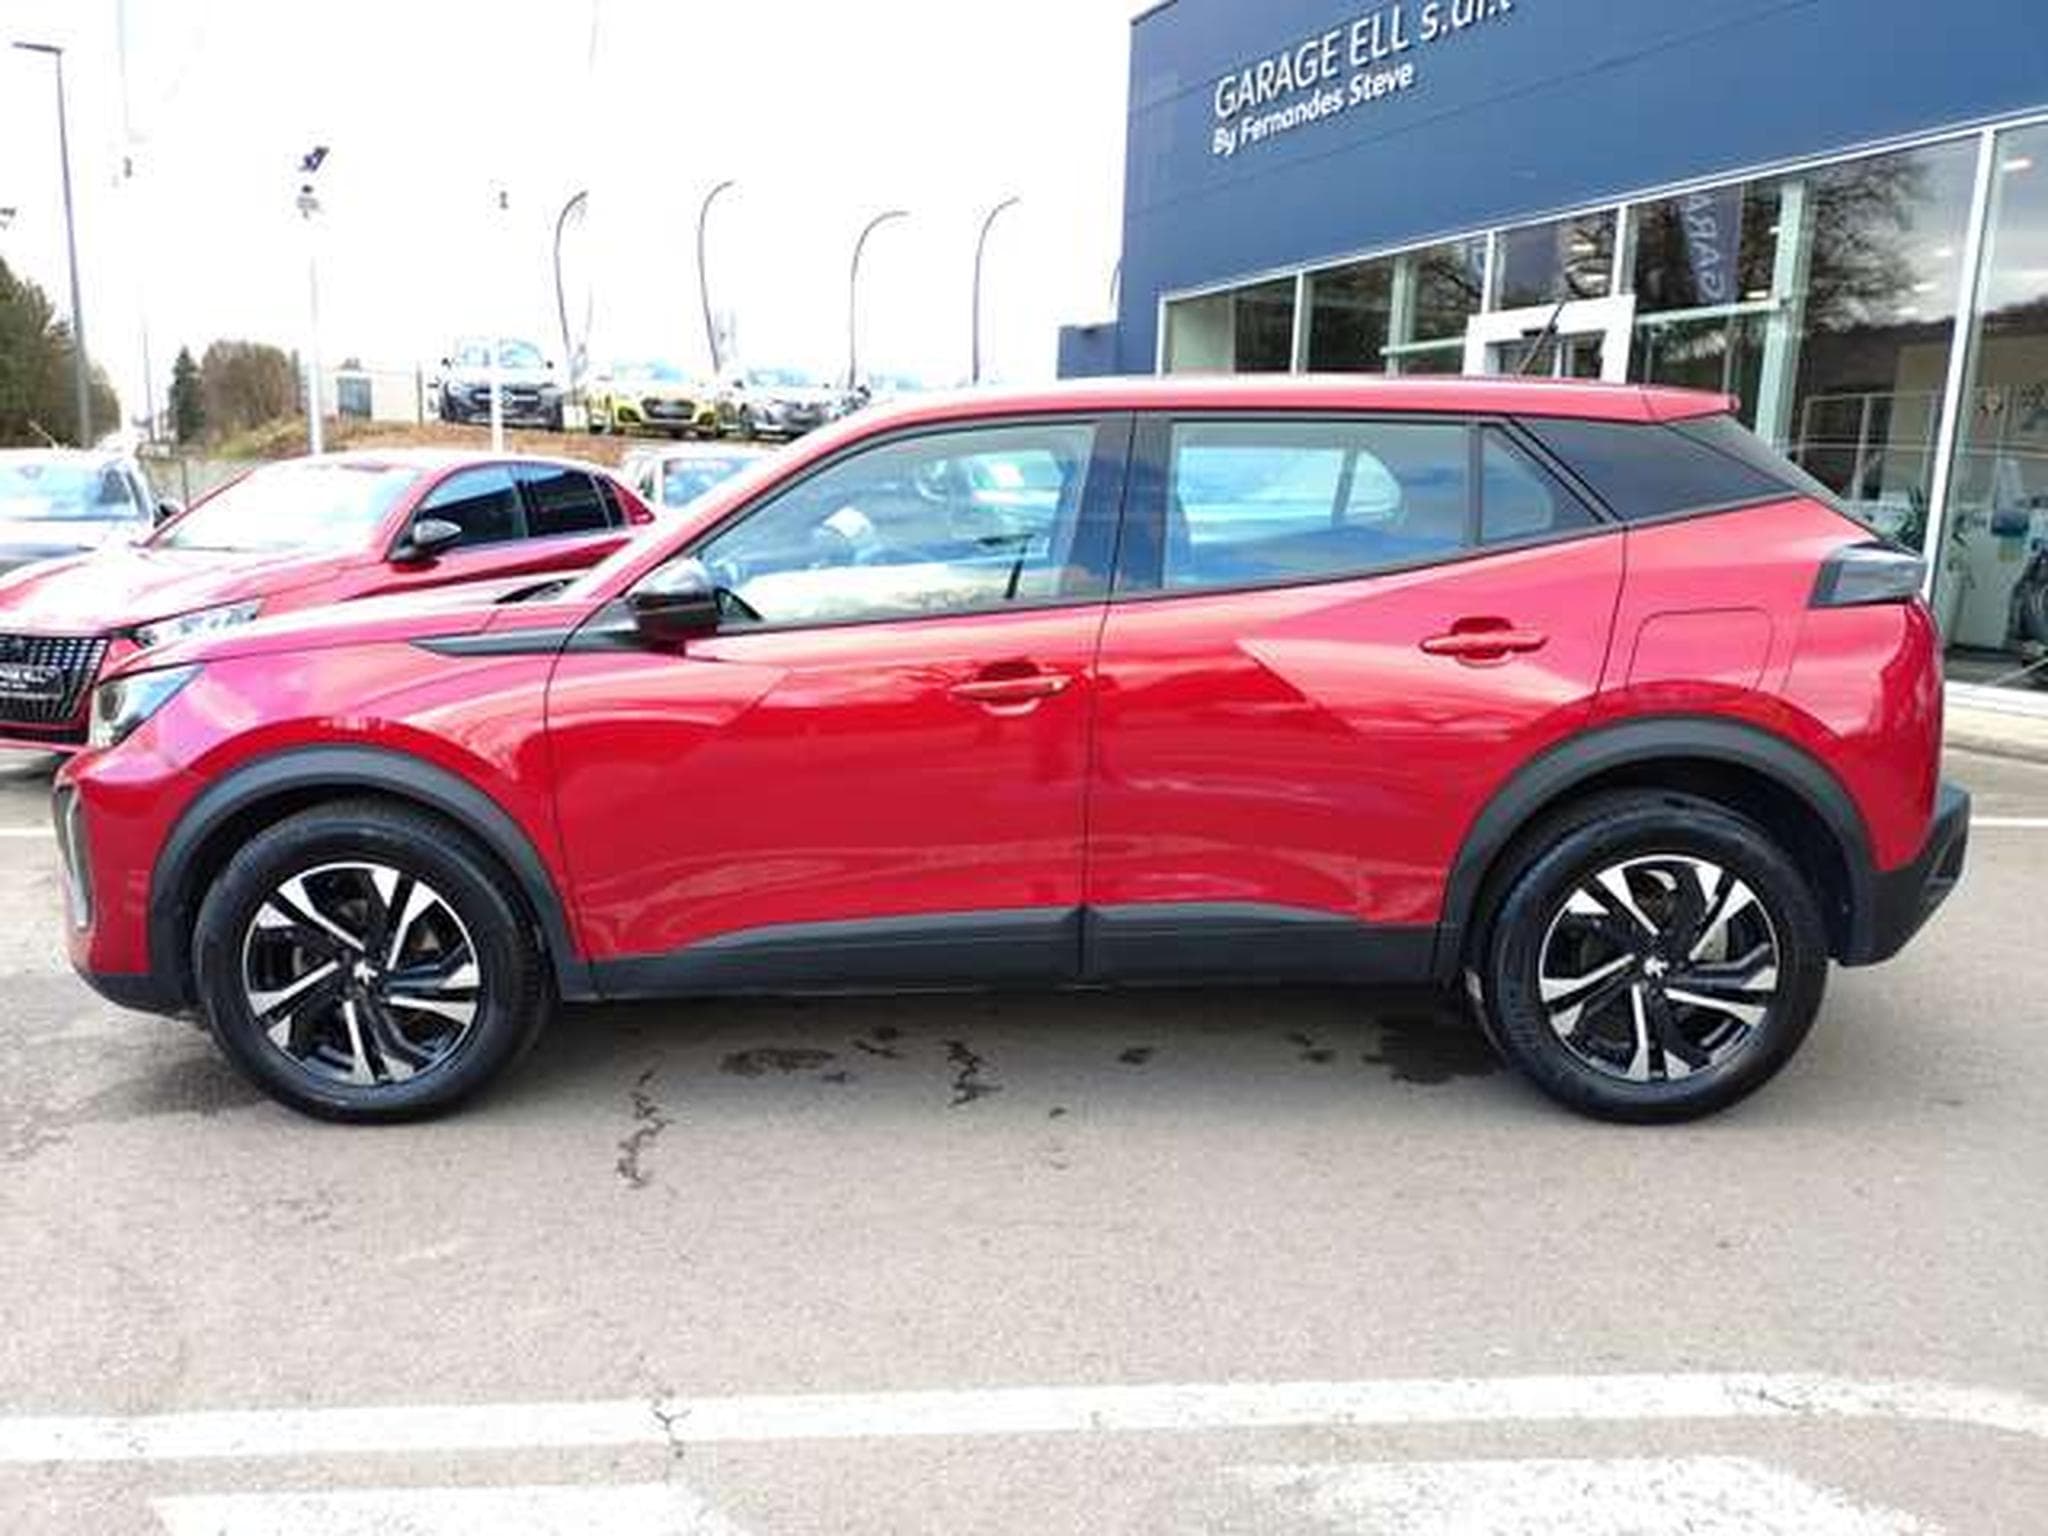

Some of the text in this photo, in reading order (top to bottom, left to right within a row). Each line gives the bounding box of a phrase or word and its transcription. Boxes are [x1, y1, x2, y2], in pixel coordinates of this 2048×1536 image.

[1212, 63, 1415, 156] By Fernandes Steve
[1215, 31, 1341, 118] GARAGE
[1350, 5, 1410, 67] ELL
